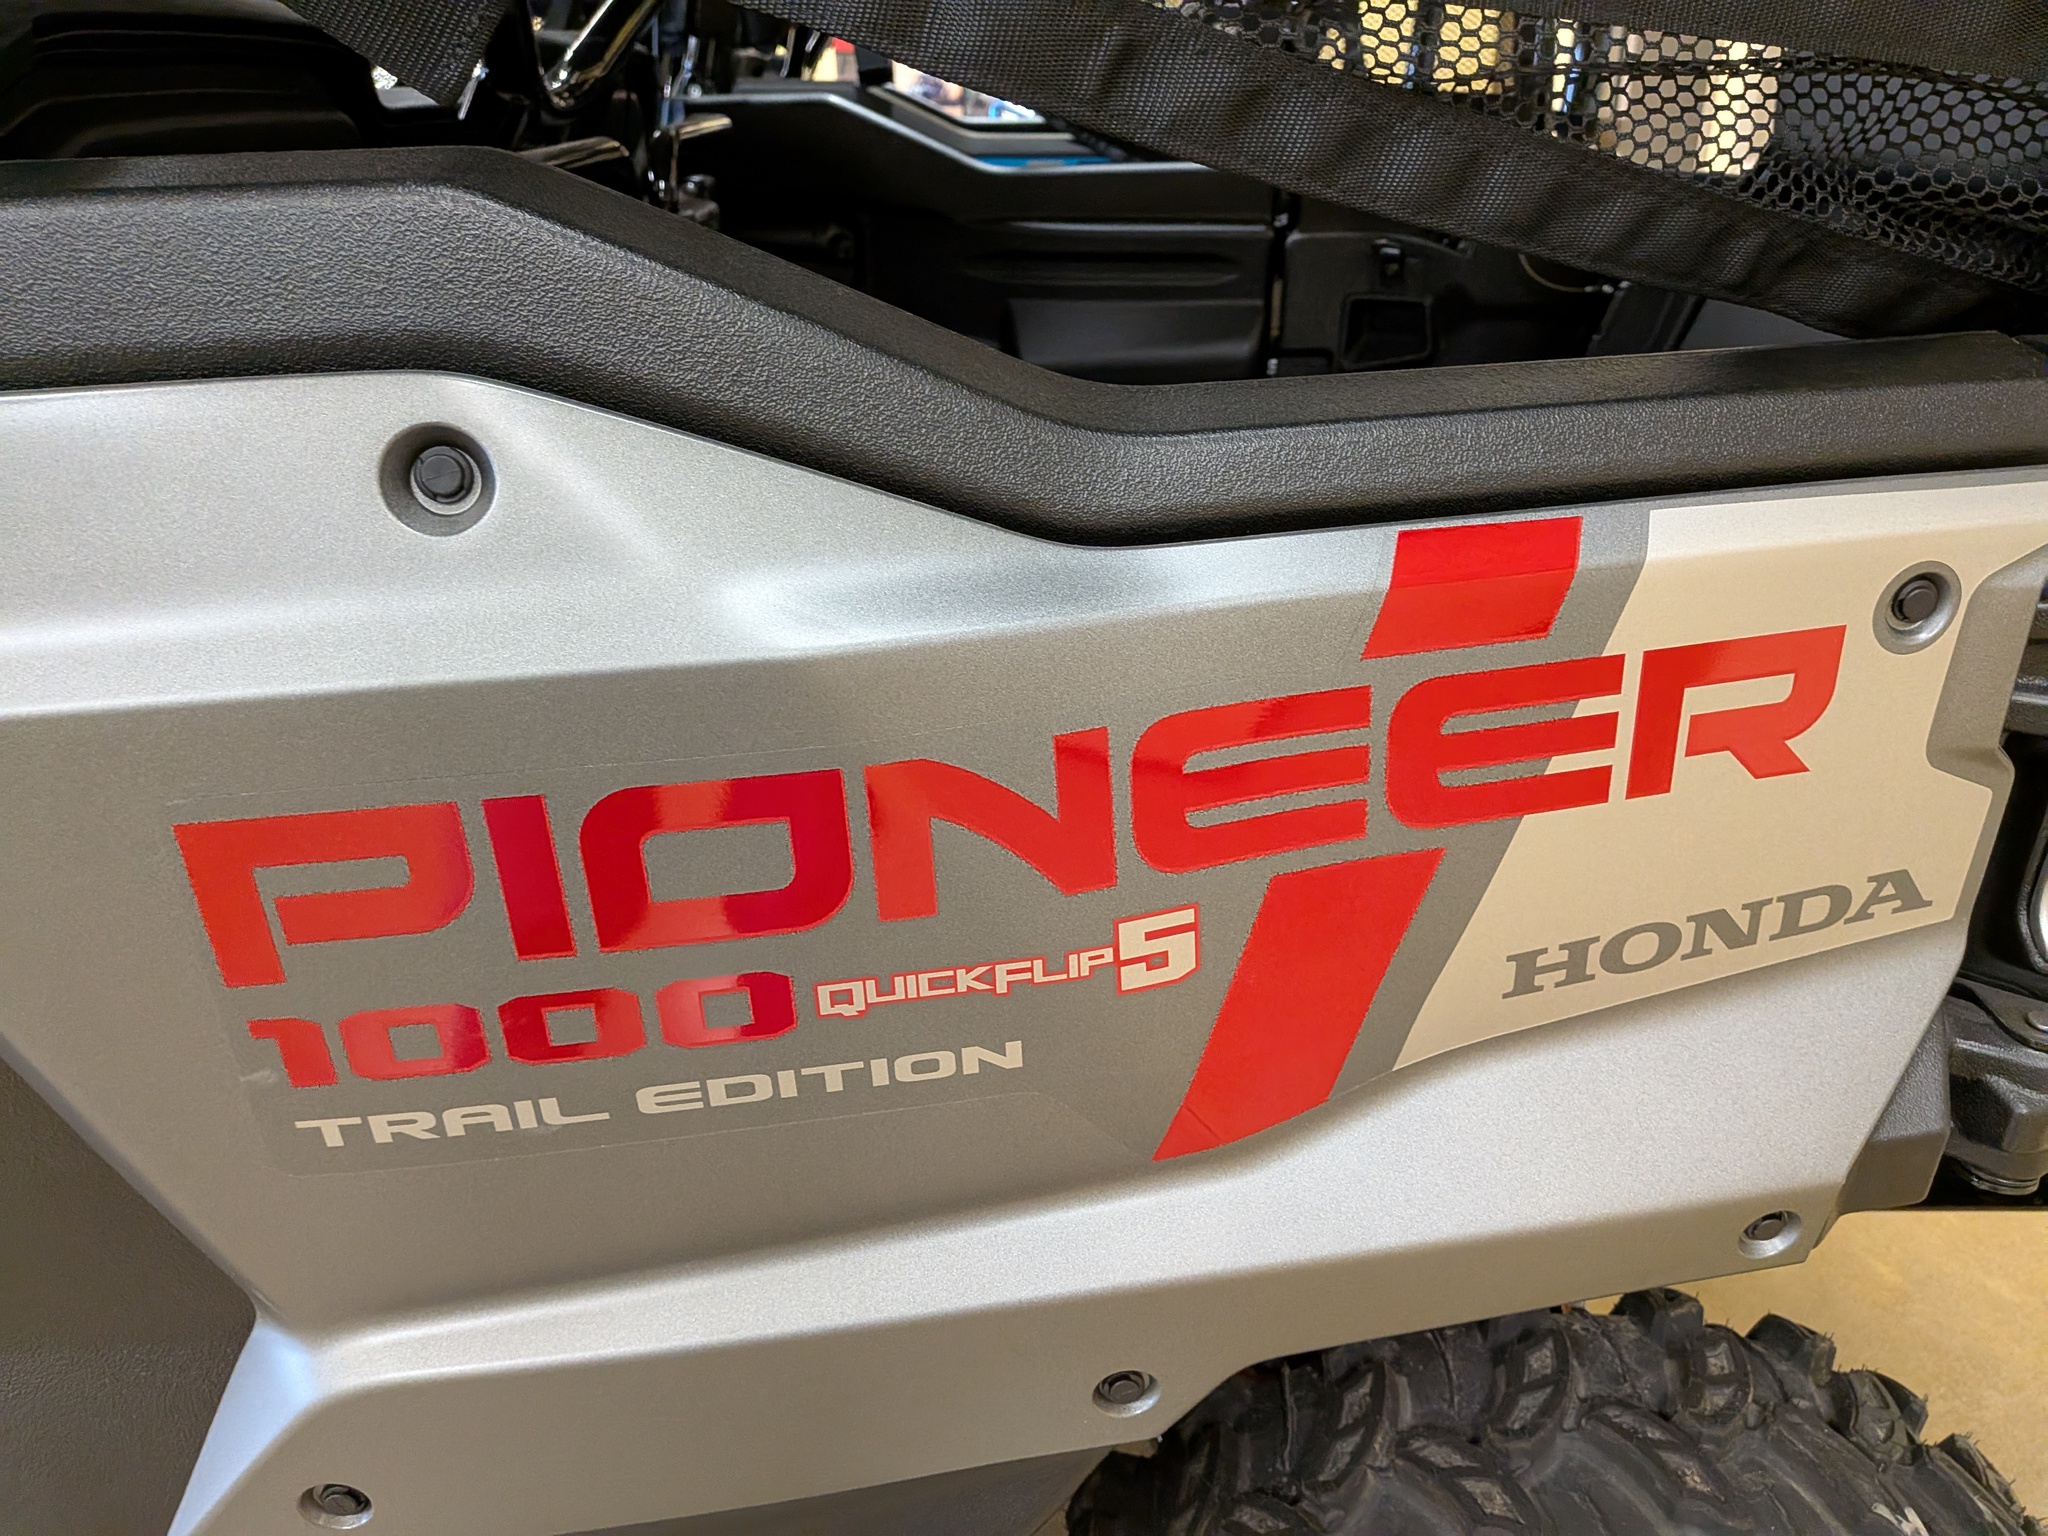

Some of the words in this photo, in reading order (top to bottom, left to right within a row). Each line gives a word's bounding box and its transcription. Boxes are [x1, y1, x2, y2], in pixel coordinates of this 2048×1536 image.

[173, 625, 1847, 987] PIONEER
[1501, 868, 1933, 998] HONDA
[248, 971, 797, 1088] 1000
[294, 1097, 611, 1148] TRAIL
[635, 1040, 1023, 1115] EDITION
